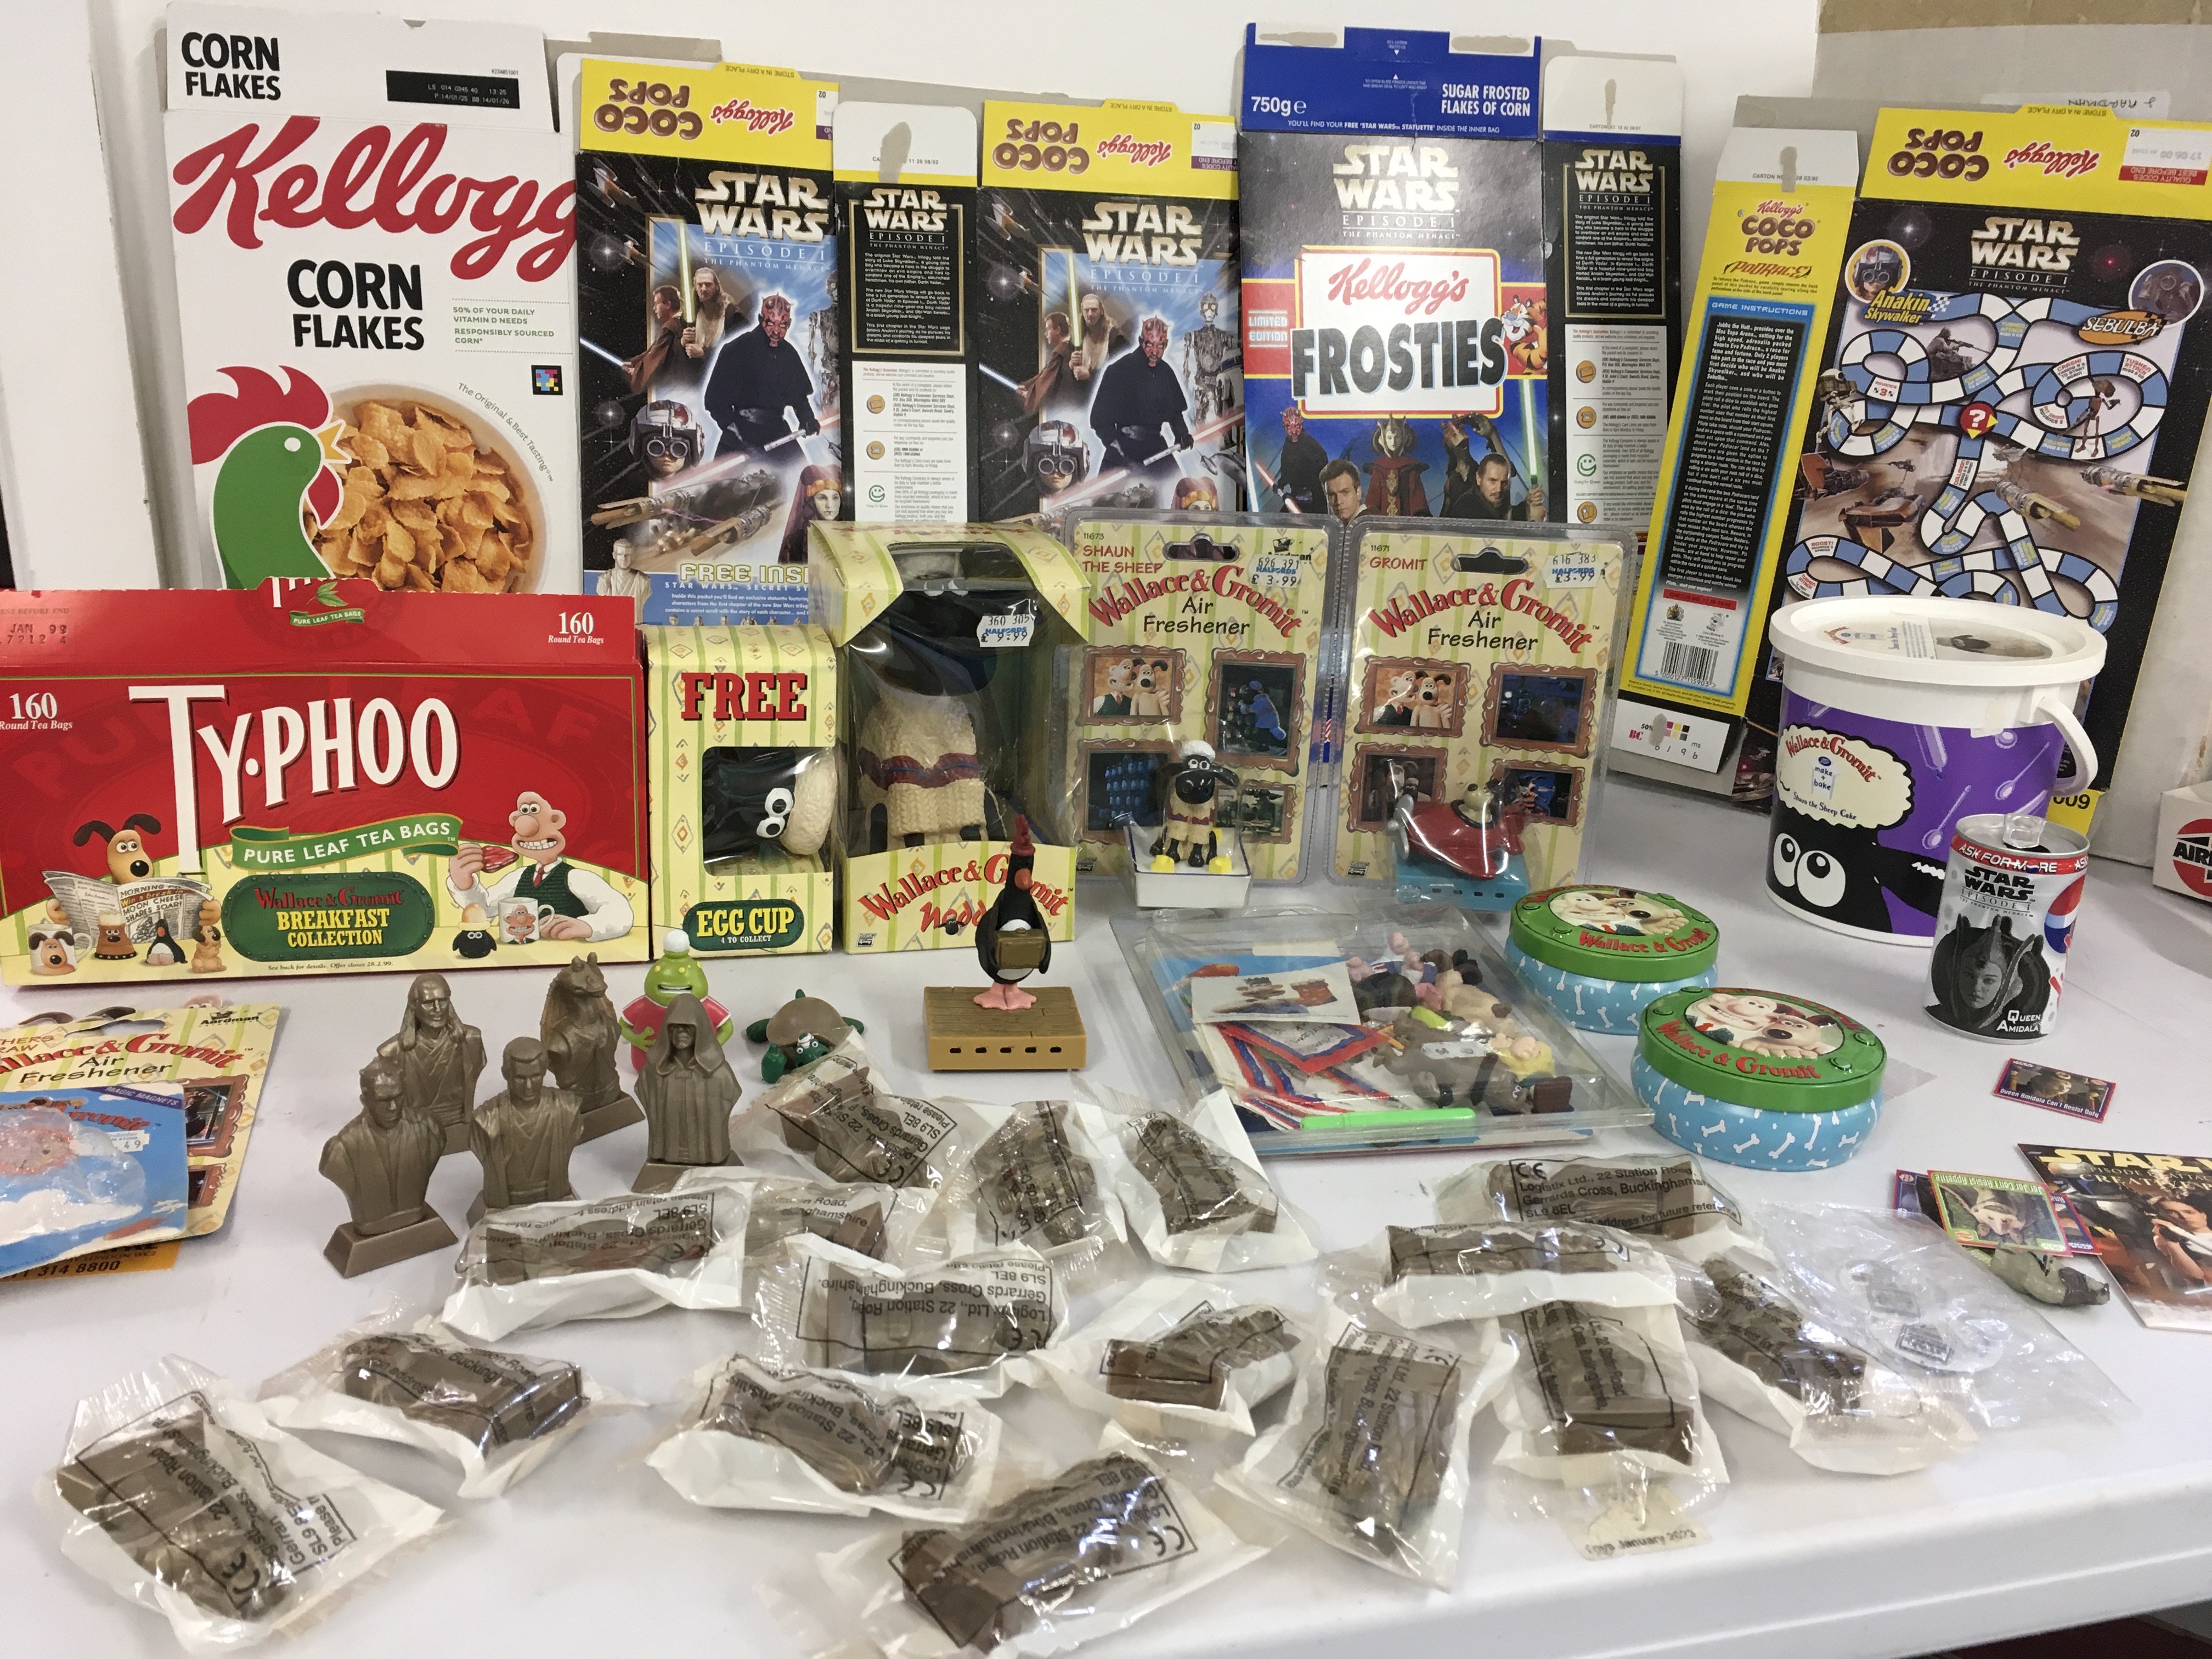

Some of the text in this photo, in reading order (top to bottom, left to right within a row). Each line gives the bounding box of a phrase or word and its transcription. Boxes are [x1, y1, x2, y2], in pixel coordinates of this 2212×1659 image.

[182, 32, 280, 71] CORN
[185, 71, 281, 100] FLAKES
[609, 78, 690, 108] POPS
[1443, 83, 1479, 99] SUGAR
[1483, 85, 1530, 100] FROSTED
[710, 99, 795, 136] Kellogg's
[1441, 99, 1531, 116] FLAKES OF CORN
[594, 104, 703, 140] COCO
[1007, 119, 1079, 144] POPS
[1096, 134, 1172, 166] Kellogg's
[1905, 128, 1983, 153] POPS
[992, 142, 1090, 174] COCO
[1333, 145, 1458, 177] STAR
[1575, 149, 1653, 170] STAR
[1888, 150, 1989, 182] COCO
[2004, 142, 2100, 178] Kellogg's
[695, 170, 828, 210] STAR
[1575, 171, 1654, 193] WARS
[864, 188, 947, 210] STAR
[1334, 178, 1459, 211] WARS
[1579, 194, 1645, 203] EPISODE
[864, 209, 947, 231] WARS
[1082, 202, 1202, 235] STAR
[1343, 214, 1437, 227] EPISODE
[1757, 200, 1803, 218] Kellogg's
[695, 204, 829, 242] WARS
[1741, 215, 1815, 239] COCO
[1972, 217, 2080, 244] STAR
[870, 233, 934, 242] EPISODE
[1745, 237, 1802, 256] POPS
[704, 241, 811, 259] EPISODE
[1082, 233, 1202, 266] WARS
[1971, 241, 2078, 271] WARS
[287, 259, 422, 311] CORN
[1091, 269, 1181, 283] EPISODE
[1328, 258, 1469, 314] Kellogg's
[1970, 268, 2059, 283] EPISODE
[1741, 304, 1808, 316] INSTRUCTIONS
[1870, 290, 1931, 312] Anakin
[1249, 316, 1288, 327] LIMITED
[1864, 307, 1922, 325] Skywalker
[2083, 316, 2159, 337] SEBULBA
[293, 314, 424, 351] FLAKES
[1249, 330, 1288, 342] EDITION
[1291, 317, 1507, 400] FROSTIES
[475, 393, 507, 419] Original
[1083, 545, 1135, 558] SHAUN
[680, 563, 751, 582] FREE
[1082, 561, 1163, 574] THE SHEEP
[1369, 556, 1427, 571] GROMIT
[1088, 565, 1303, 639] Wallace & Gromit
[1182, 598, 1214, 614] Air
[558, 611, 595, 636] 160
[988, 616, 1006, 625] 360
[1143, 616, 1250, 636] Freshener
[1367, 578, 1594, 654] Wallace & Gromit
[1467, 613, 1502, 629] Air
[10, 624, 33, 633] JAN
[1427, 628, 1538, 651] Freshener
[548, 635, 605, 646] Round Bags
[9, 692, 58, 720] 160
[681, 673, 808, 721] FREE
[31, 720, 72, 731] Tea Bags
[1786, 735, 1877, 782] Wallace Gromit
[1815, 766, 1832, 777] make
[1814, 779, 1831, 791] bake
[1793, 792, 1857, 820] Shaun the Sheep Cake
[244, 823, 450, 864] PURE LEAF TEA BAGS
[1959, 843, 2009, 868] ASK FOR
[1965, 866, 2035, 889] STAR
[1965, 874, 2033, 901] WARS
[254, 887, 323, 909] Wallace
[857, 860, 982, 921] Wallace &
[1961, 888, 2016, 910] EPISODE
[276, 908, 390, 931] BREAKFAST
[696, 907, 795, 937] EGG CUP
[287, 929, 382, 948] COLLECTION
[740, 935, 771, 943] COLLECT
[1579, 932, 1650, 953] Wallace
[125, 1033, 245, 1068] Gromit
[1656, 1019, 1822, 1080] Wallace Gromit
[19, 1064, 173, 1083] Freshener
[78, 1056, 124, 1068] Air
[105, 1086, 182, 1106] MAGIC MAGNETS
[2000, 1088, 2099, 1118] Queen Amidala Can't Resist Duty
[2040, 1149, 2202, 1173] STAR
[76, 1260, 121, 1273] 8800
[986, 1288, 1047, 1304] Gerrards
